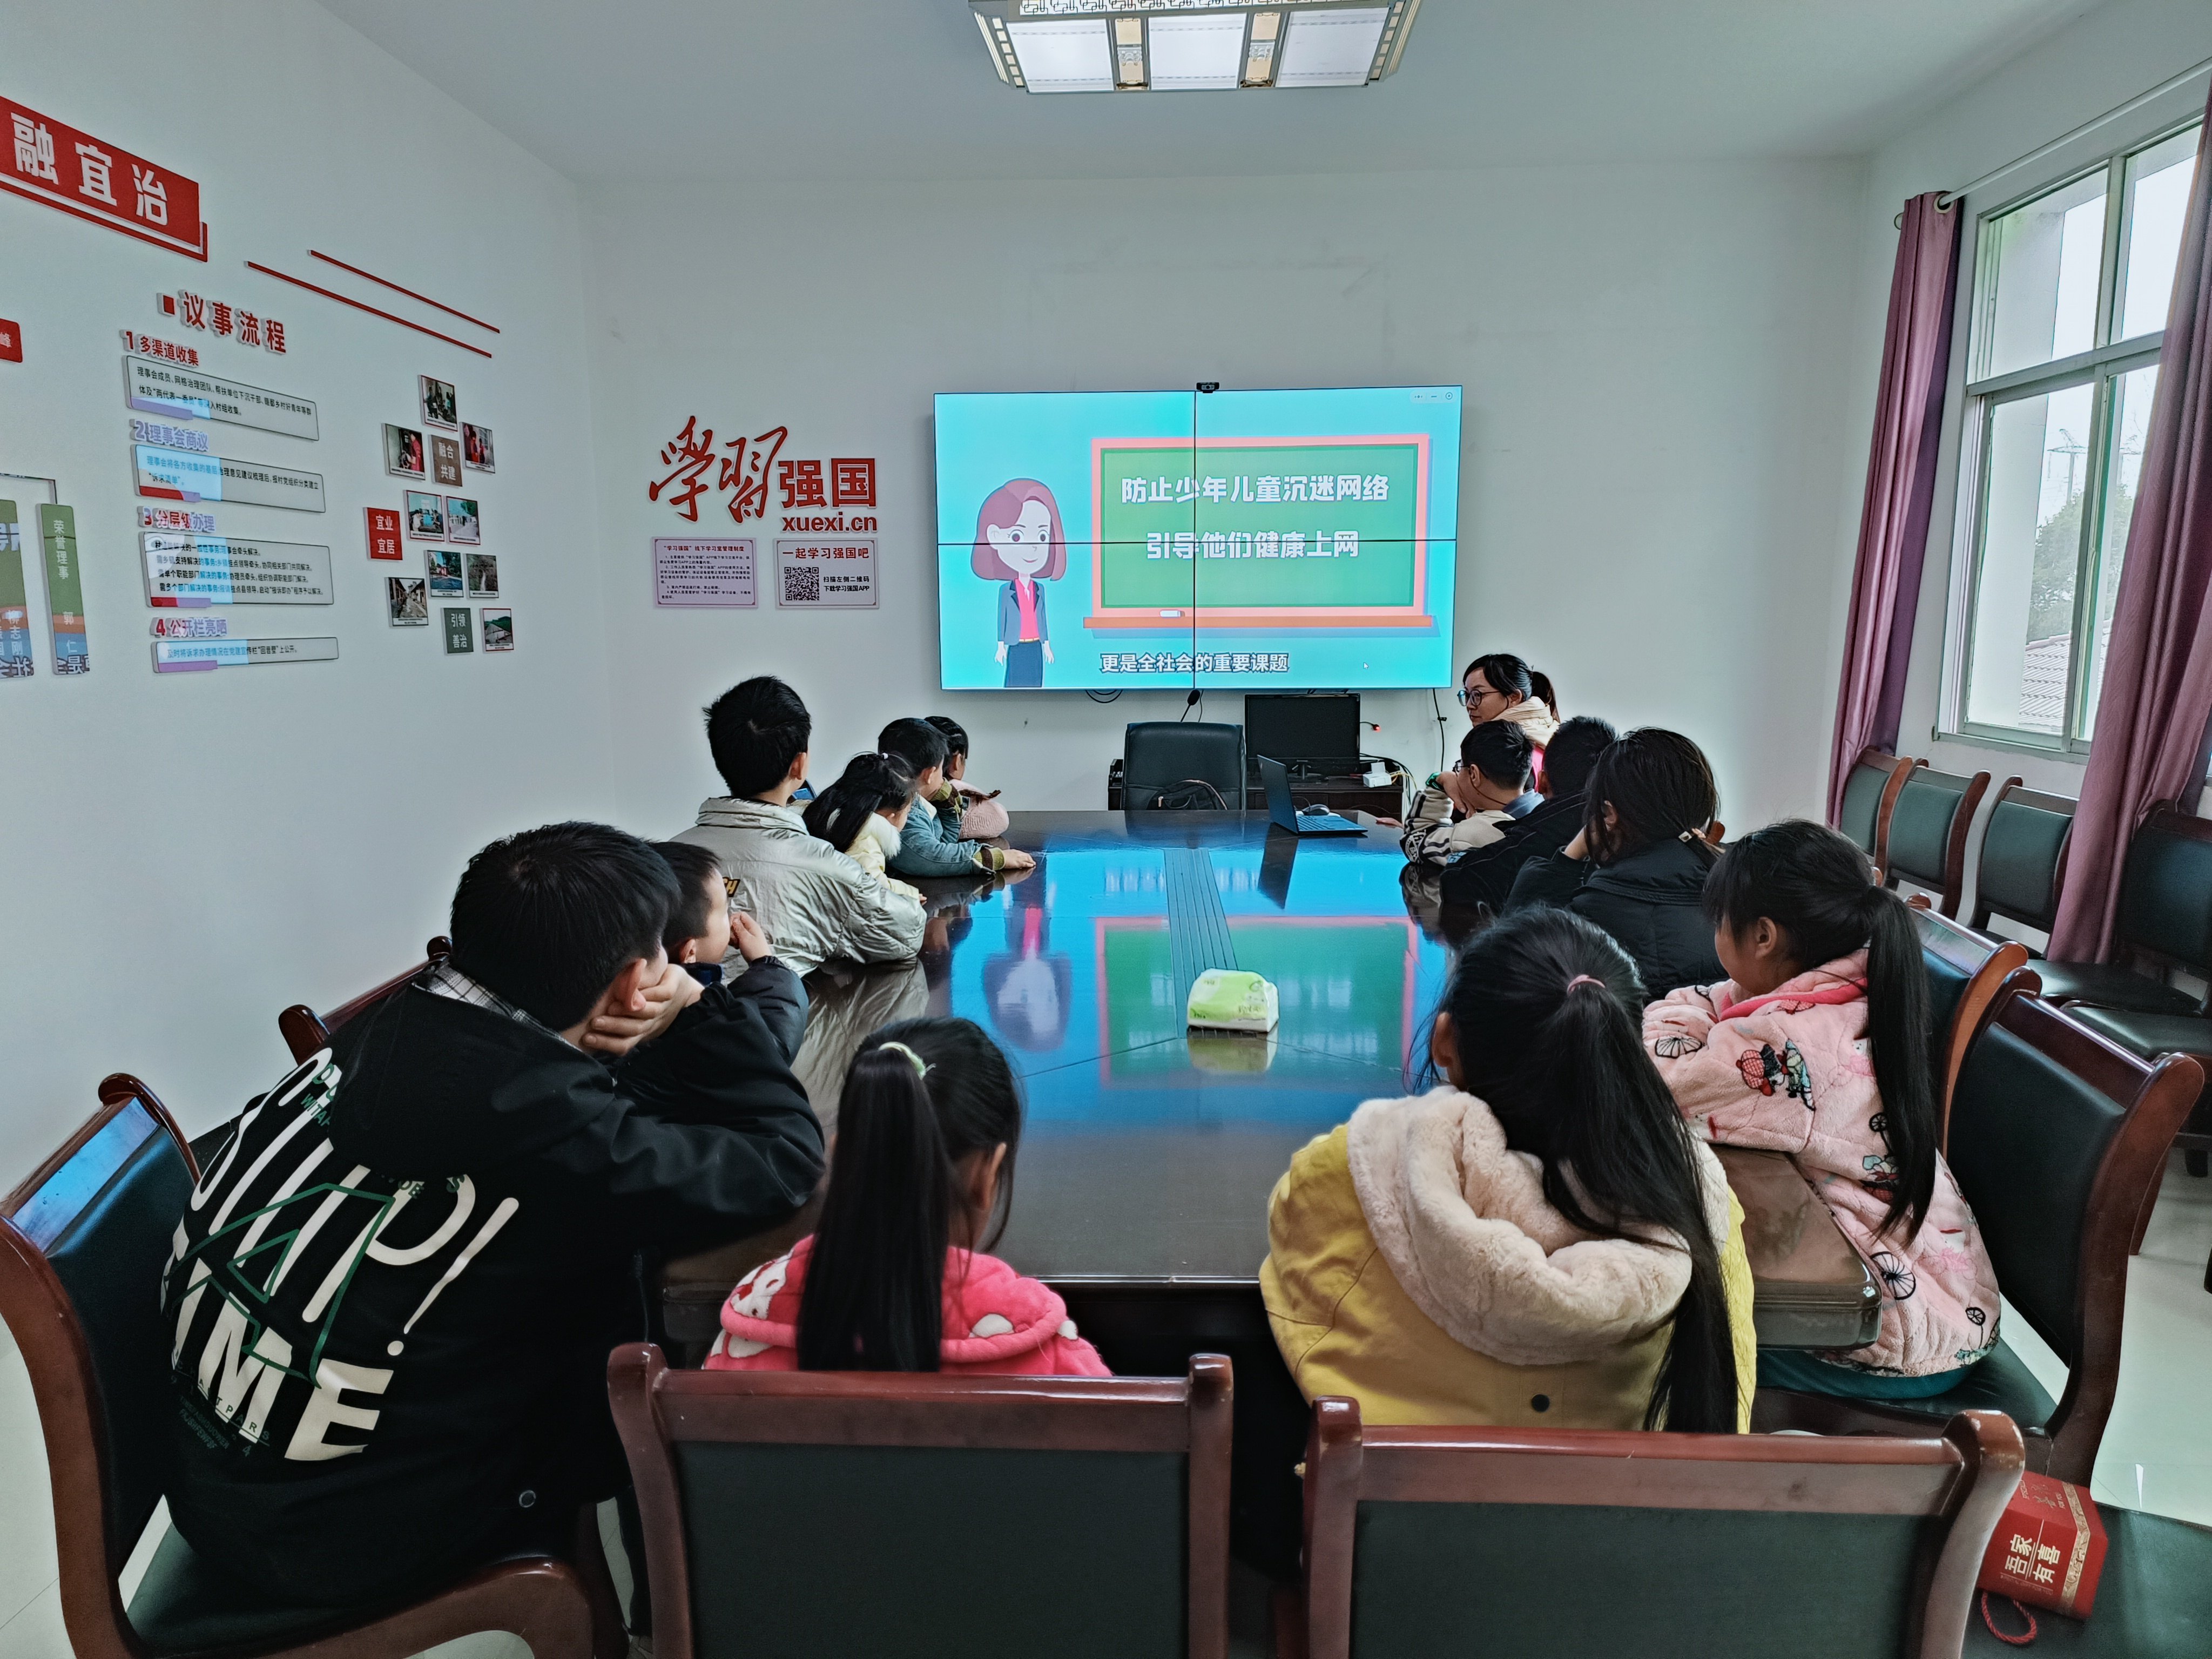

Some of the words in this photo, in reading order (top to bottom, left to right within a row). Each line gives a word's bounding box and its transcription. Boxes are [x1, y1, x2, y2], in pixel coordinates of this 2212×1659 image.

[11, 112, 167, 226] 融宜治
[184, 291, 286, 354] 议事流程
[125, 331, 133, 350] 1
[140, 335, 199, 366] 多渠道收集
[136, 421, 145, 439] 2
[150, 424, 208, 450] 理事会商议
[438, 442, 454, 459] 融合
[440, 464, 456, 481] 共建
[1121, 475, 1390, 503] 防止少年儿童沉迷网络
[144, 508, 152, 525] 3
[157, 510, 215, 531] 分层级办理
[375, 515, 394, 531] 宜业
[783, 511, 877, 531] xuexi.cn
[53, 520, 69, 579] 荣誉理事
[377, 538, 395, 555] 宜居
[783, 548, 869, 559] 一起学习强国吧
[1147, 530, 1359, 559] 引导他们健康上网
[156, 619, 165, 636] 4
[171, 619, 227, 636] 公开栏亮晒
[451, 613, 466, 628] 引领
[453, 634, 467, 648] 善治
[1100, 653, 1289, 673] 更是全社会的重要课题
